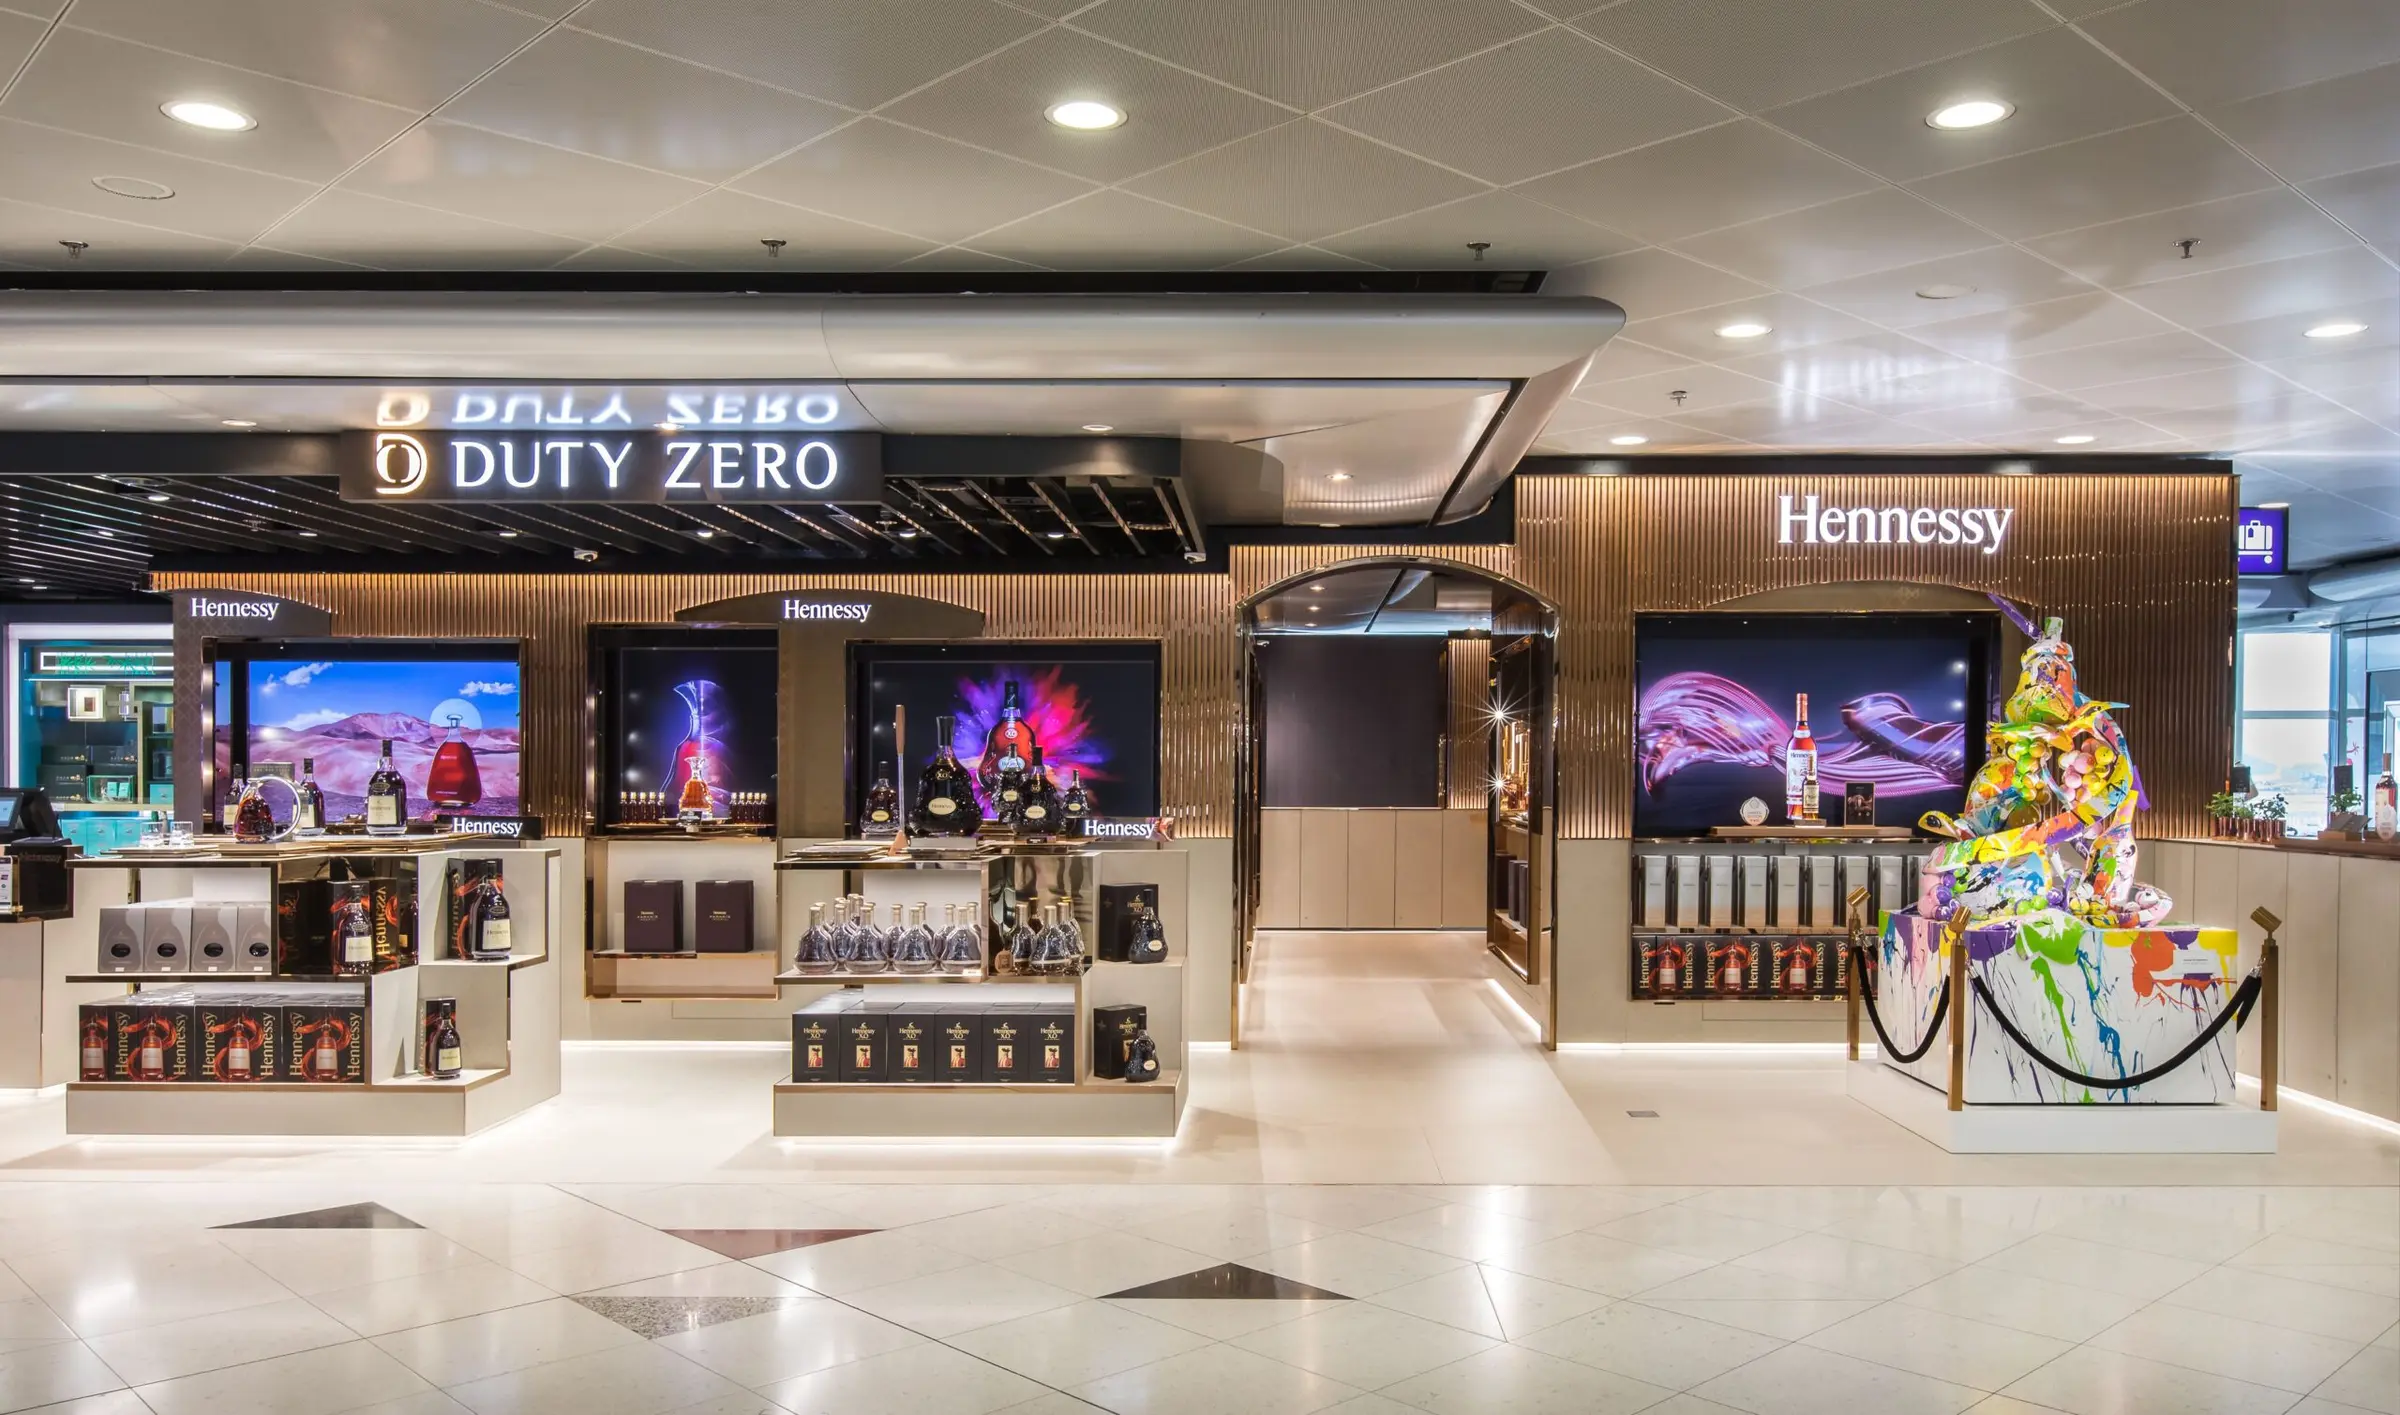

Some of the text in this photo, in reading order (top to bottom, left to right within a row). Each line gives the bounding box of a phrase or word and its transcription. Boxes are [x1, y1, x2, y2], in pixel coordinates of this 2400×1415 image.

[451, 441, 838, 489] DUTY ZERO
[1778, 495, 2014, 554] Hennessy
[191, 597, 280, 621] Hennessy
[783, 599, 872, 623] Hennessy
[453, 817, 523, 838] Hennessy
[1084, 819, 1155, 839] Hennessy
[1639, 941, 1651, 989] Hennessy
[1683, 941, 1695, 989] Hennessy
[1705, 941, 1717, 989] Hennessy
[1748, 941, 1760, 989] Hennessy
[1770, 941, 1783, 989] Hennessy
[1813, 941, 1825, 989] Hennessy
[115, 1012, 131, 1076] Hennessy
[173, 1012, 189, 1076] Hennessy
[202, 1012, 218, 1076] Hennessy
[260, 1012, 276, 1076] Hennessy
[289, 1012, 305, 1076] Hennessy
[347, 1012, 363, 1076] Hennessy
